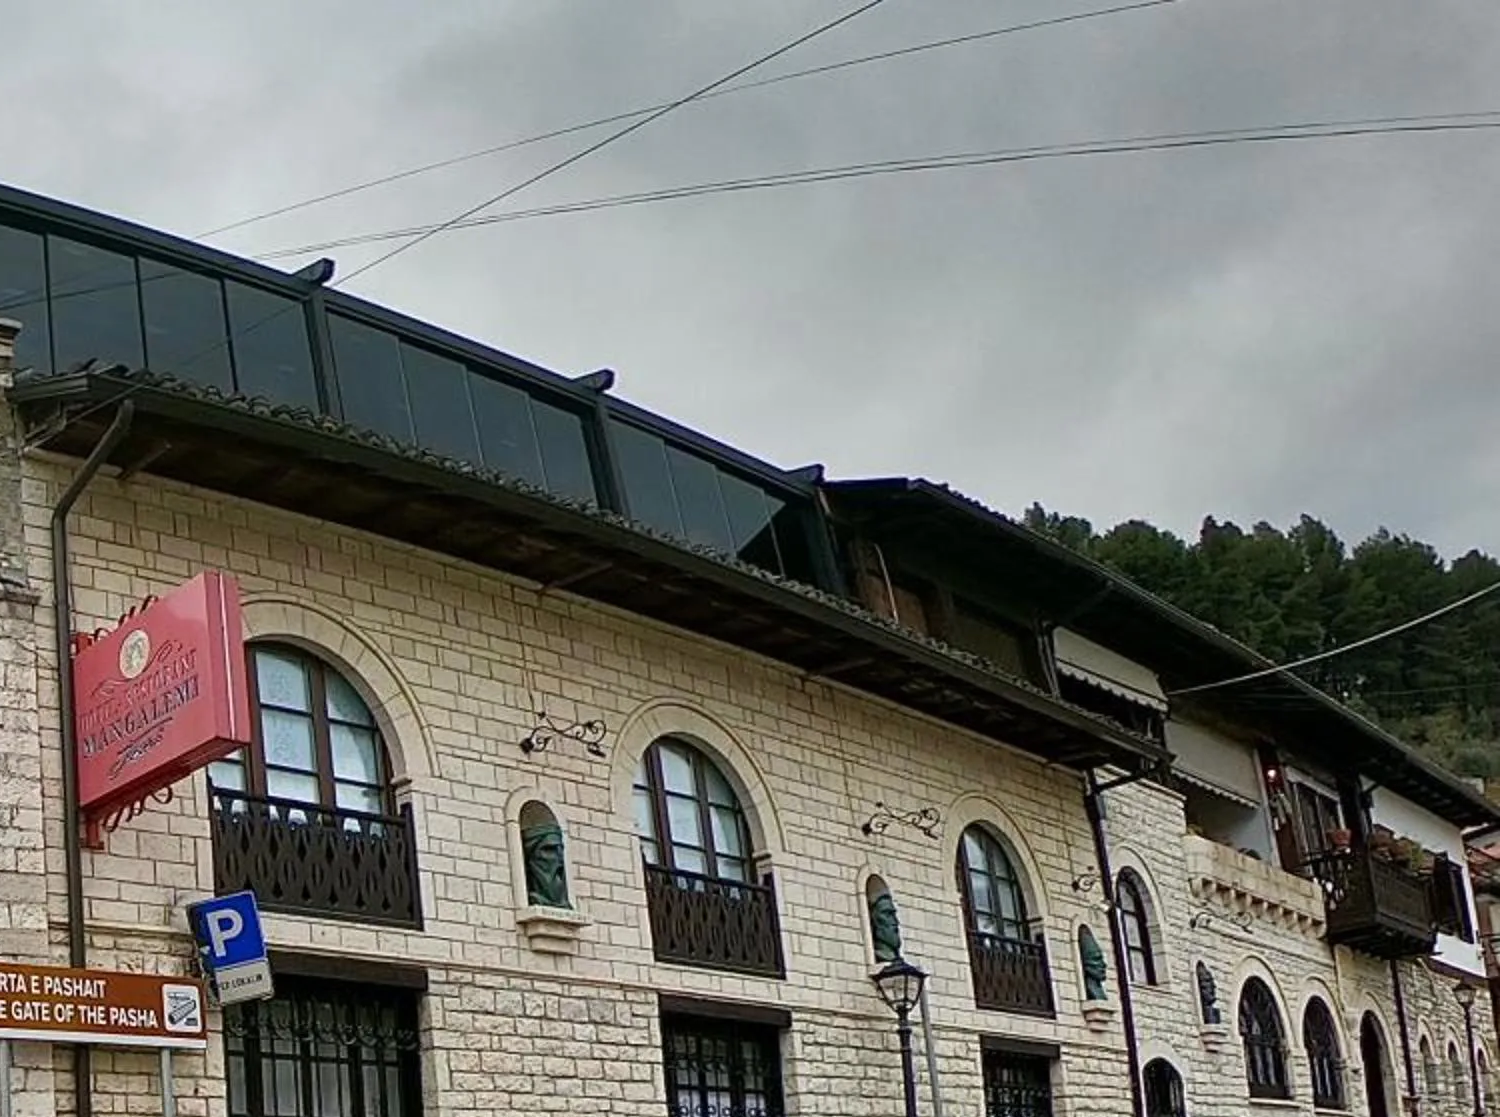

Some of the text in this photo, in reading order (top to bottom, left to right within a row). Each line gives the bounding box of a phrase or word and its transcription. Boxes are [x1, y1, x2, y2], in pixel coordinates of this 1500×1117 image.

[83, 675, 199, 758] MANGALEMI
[206, 909, 243, 957] P
[31, 976, 40, 994] E
[44, 976, 106, 998] PASHAIT
[11, 1001, 50, 1021] GATE
[54, 1005, 75, 1023] OF
[78, 1006, 104, 1025] THE
[109, 1007, 159, 1028] PASHA
